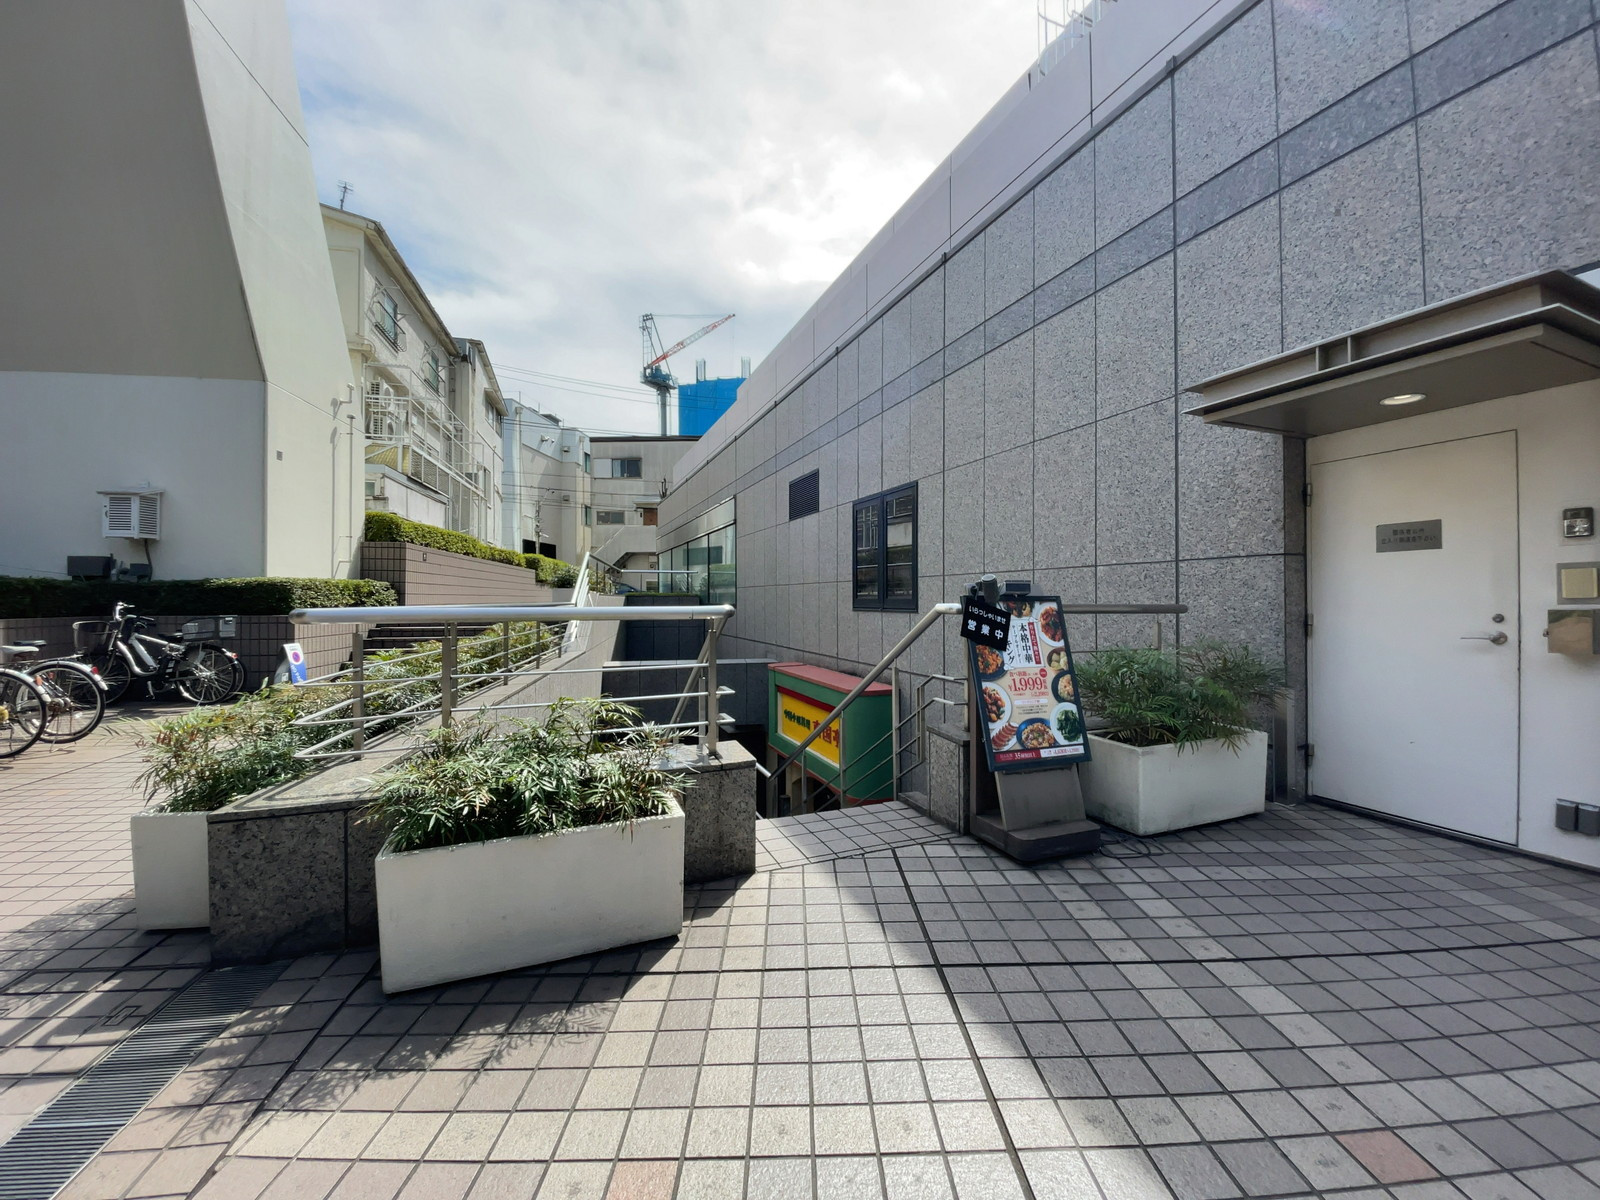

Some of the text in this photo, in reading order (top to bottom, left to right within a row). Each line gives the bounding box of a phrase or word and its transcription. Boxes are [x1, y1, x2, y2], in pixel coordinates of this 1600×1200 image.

[969, 605, 1006, 624] いらっしゃいませ
[968, 619, 1004, 640] 営業中
[1006, 640, 1015, 664] キング
[1019, 622, 1033, 664] 本格中華
